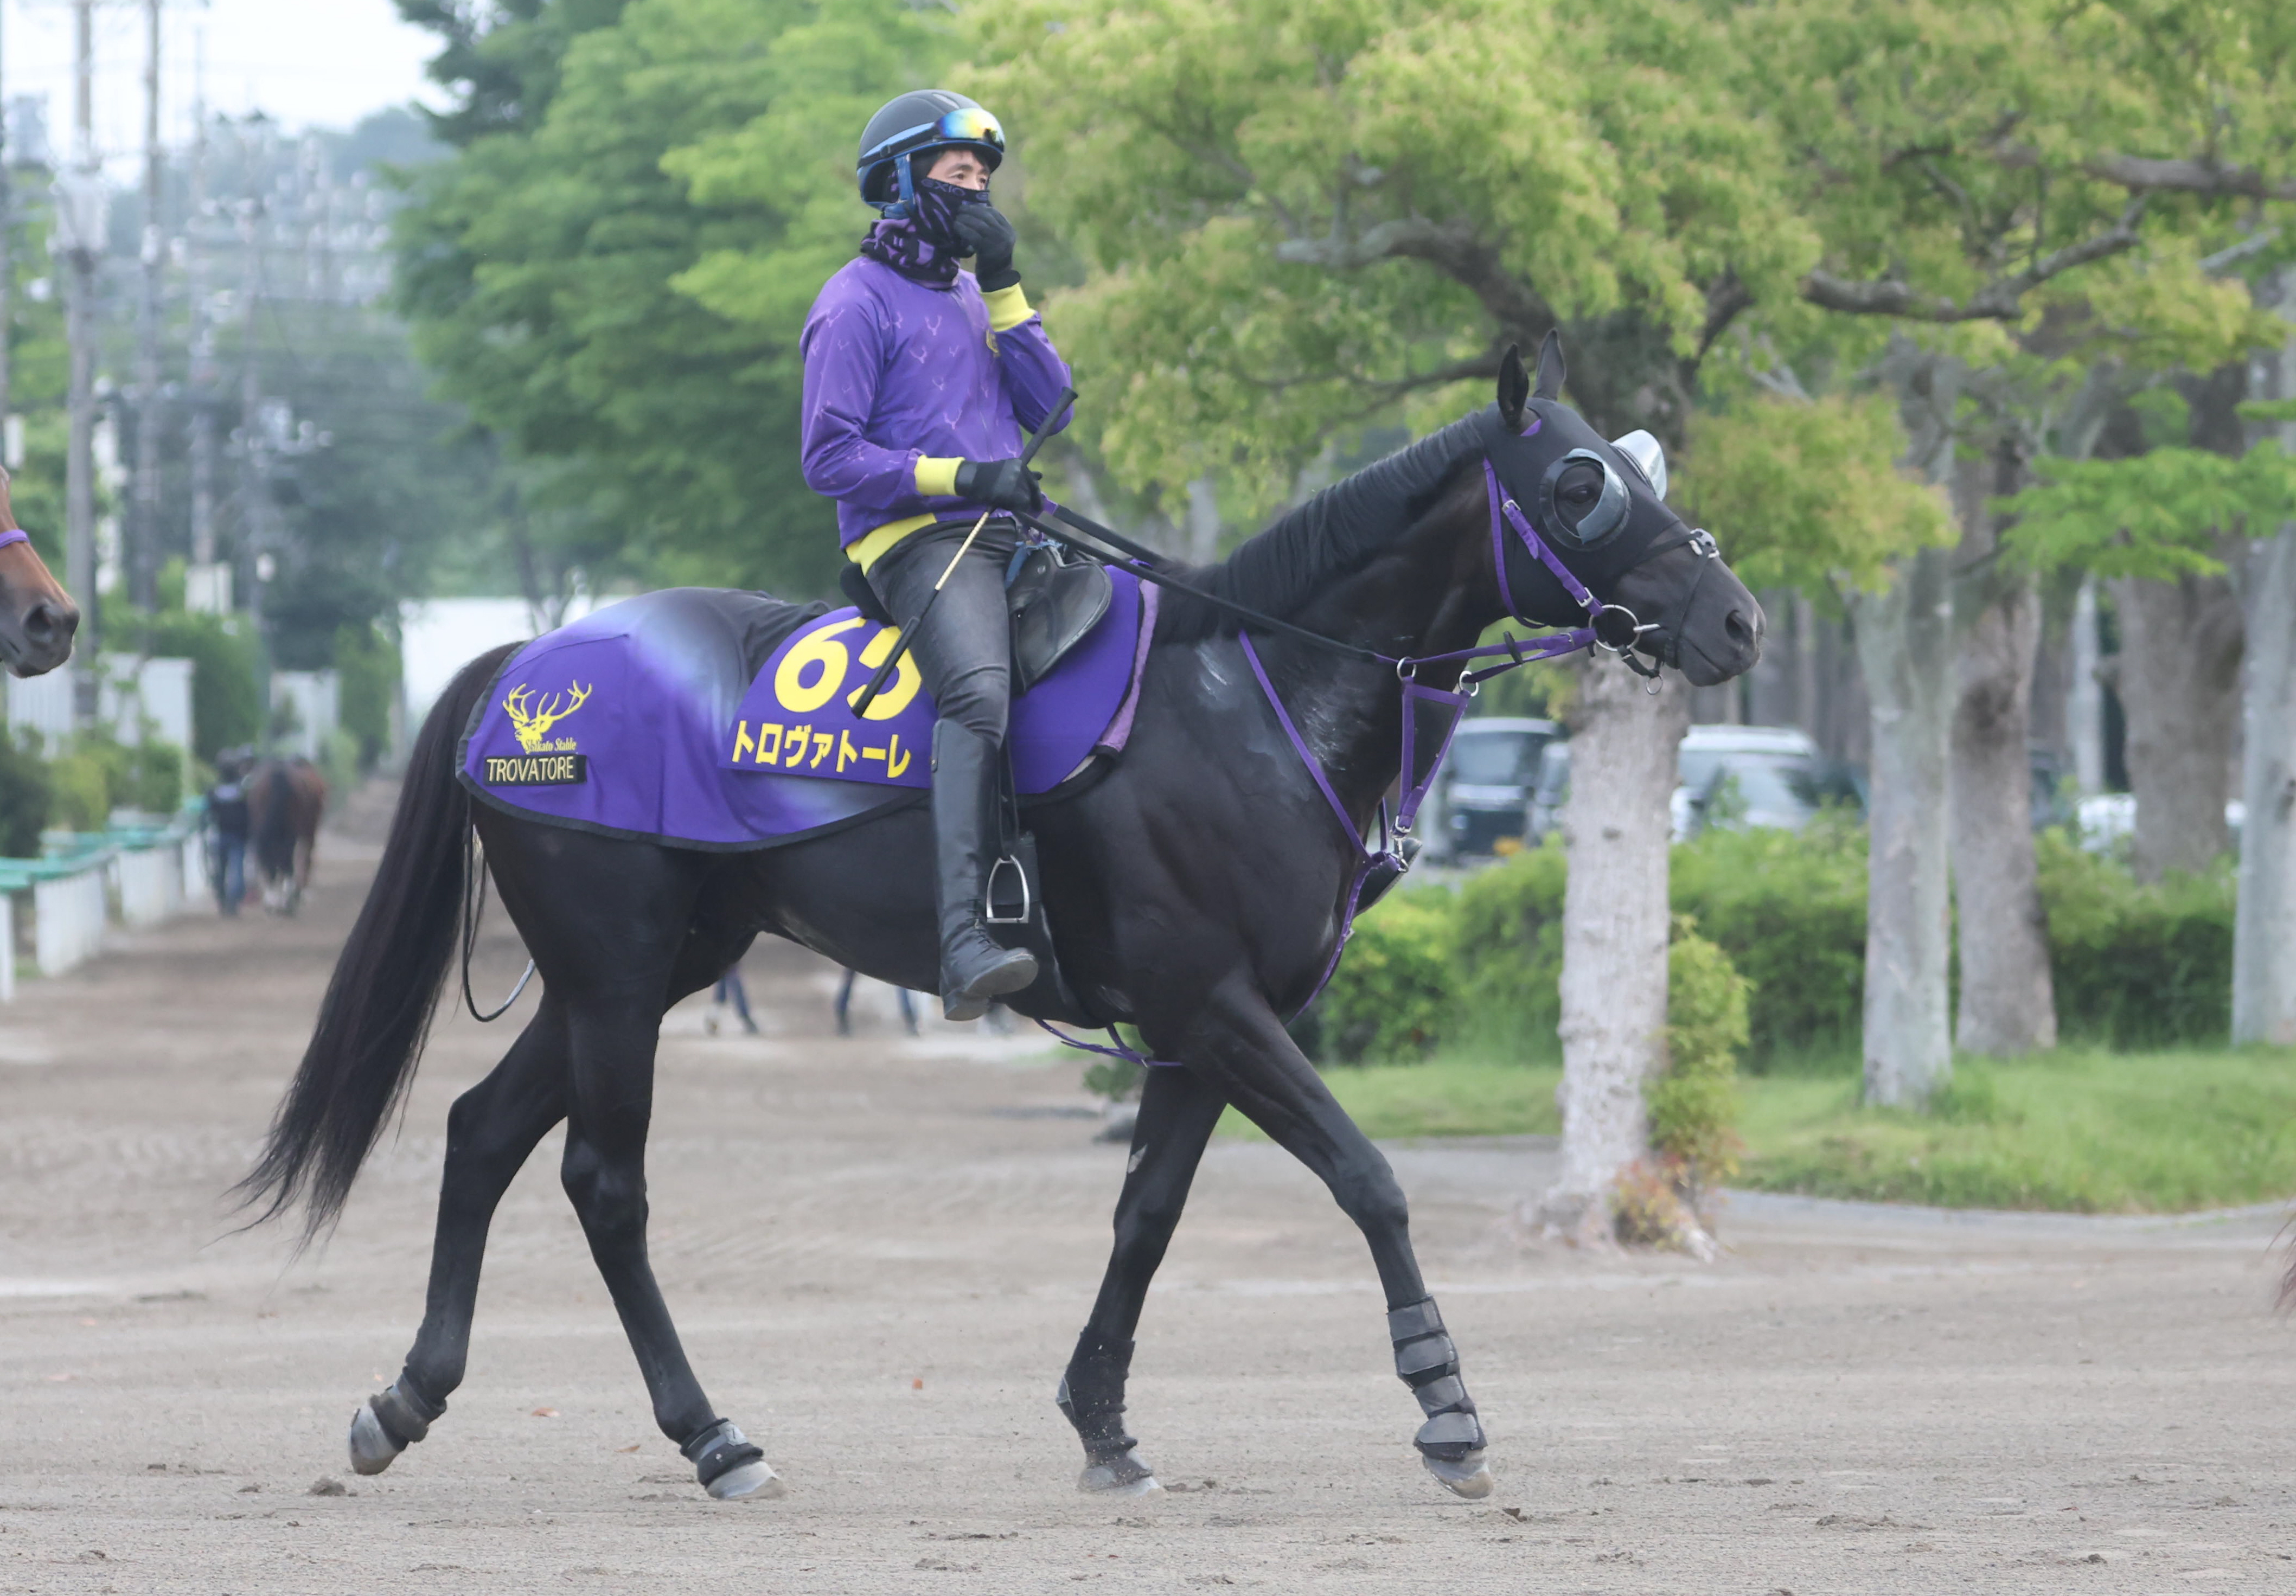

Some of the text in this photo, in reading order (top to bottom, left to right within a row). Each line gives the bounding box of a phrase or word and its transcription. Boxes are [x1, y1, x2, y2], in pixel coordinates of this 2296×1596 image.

[775, 616, 922, 721] 65
[554, 737, 577, 751] Stable
[732, 720, 912, 778] トロヴァトーレ
[487, 756, 574, 782] TROVATORE
